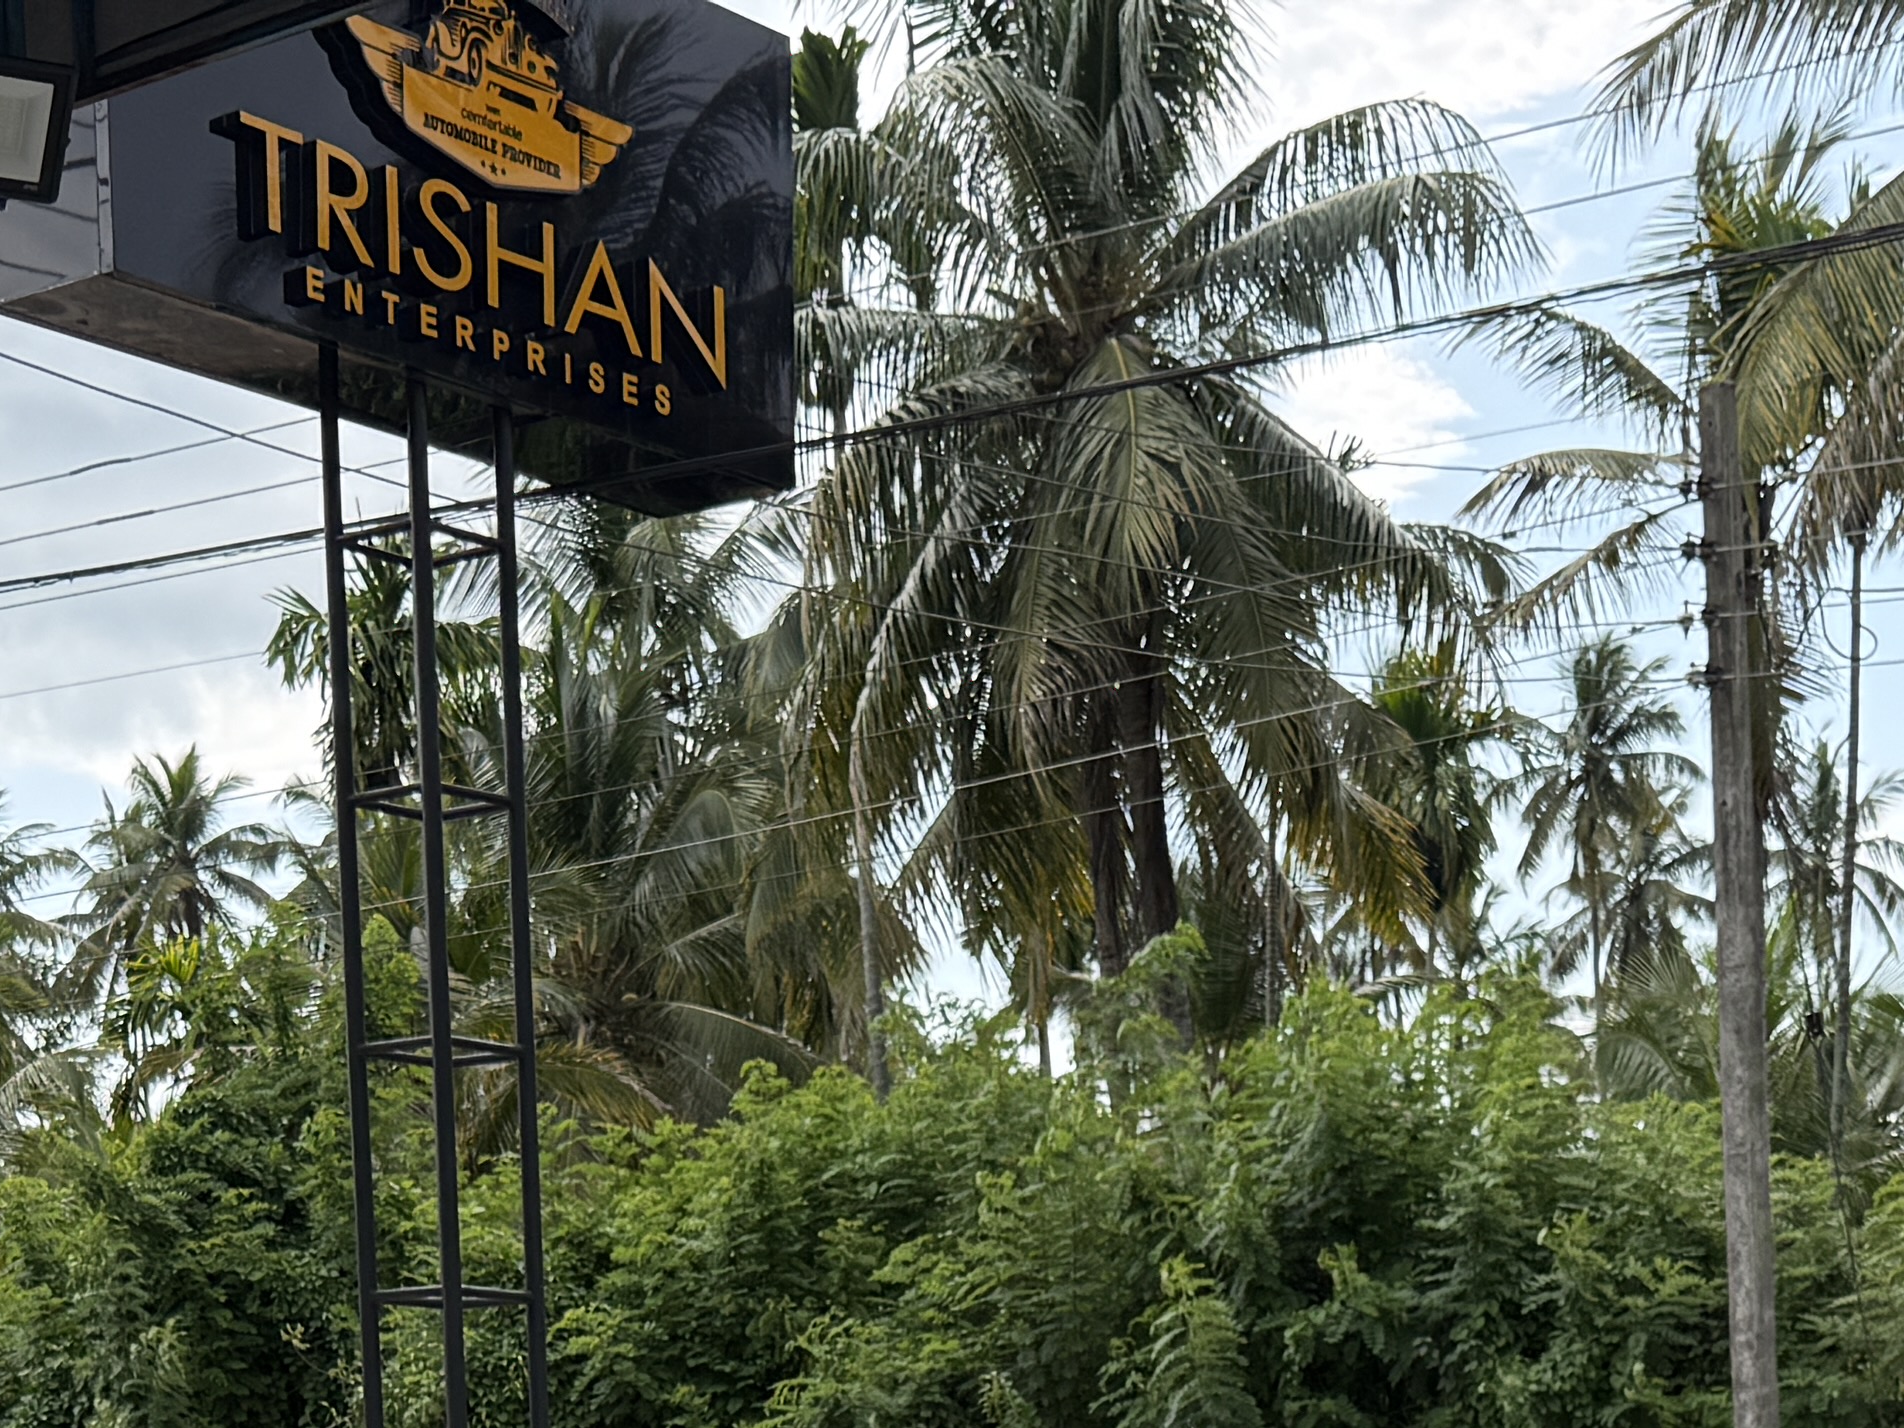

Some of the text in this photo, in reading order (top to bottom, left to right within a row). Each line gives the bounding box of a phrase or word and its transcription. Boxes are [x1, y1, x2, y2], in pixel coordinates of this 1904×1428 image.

[423, 111, 562, 181] AUTOMOBILE PROVIDER
[236, 110, 728, 392] TRISHAN
[305, 266, 673, 417] ENTERPRISES
